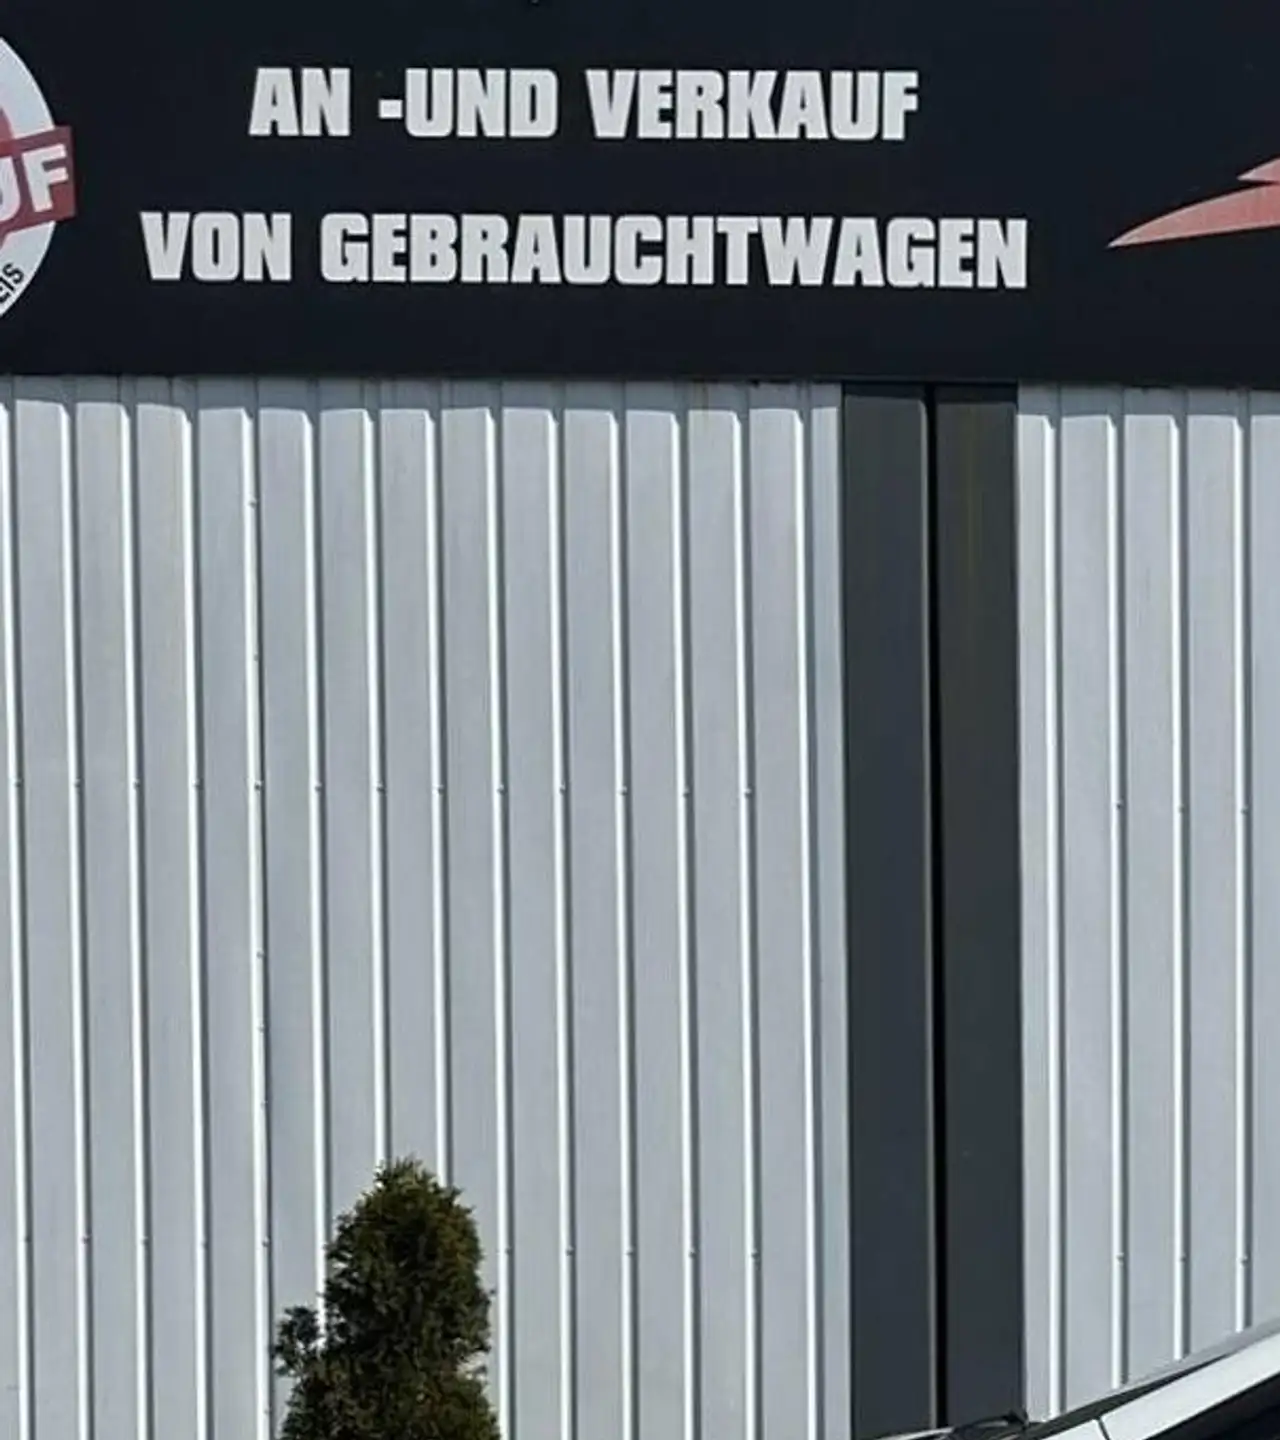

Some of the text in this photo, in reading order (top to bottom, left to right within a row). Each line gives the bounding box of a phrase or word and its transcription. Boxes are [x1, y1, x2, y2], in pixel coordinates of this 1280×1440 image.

[248, 67, 919, 141] AN -UND VERKAUF
[139, 211, 1028, 289] VON GEBRAUCHTWAGEN
